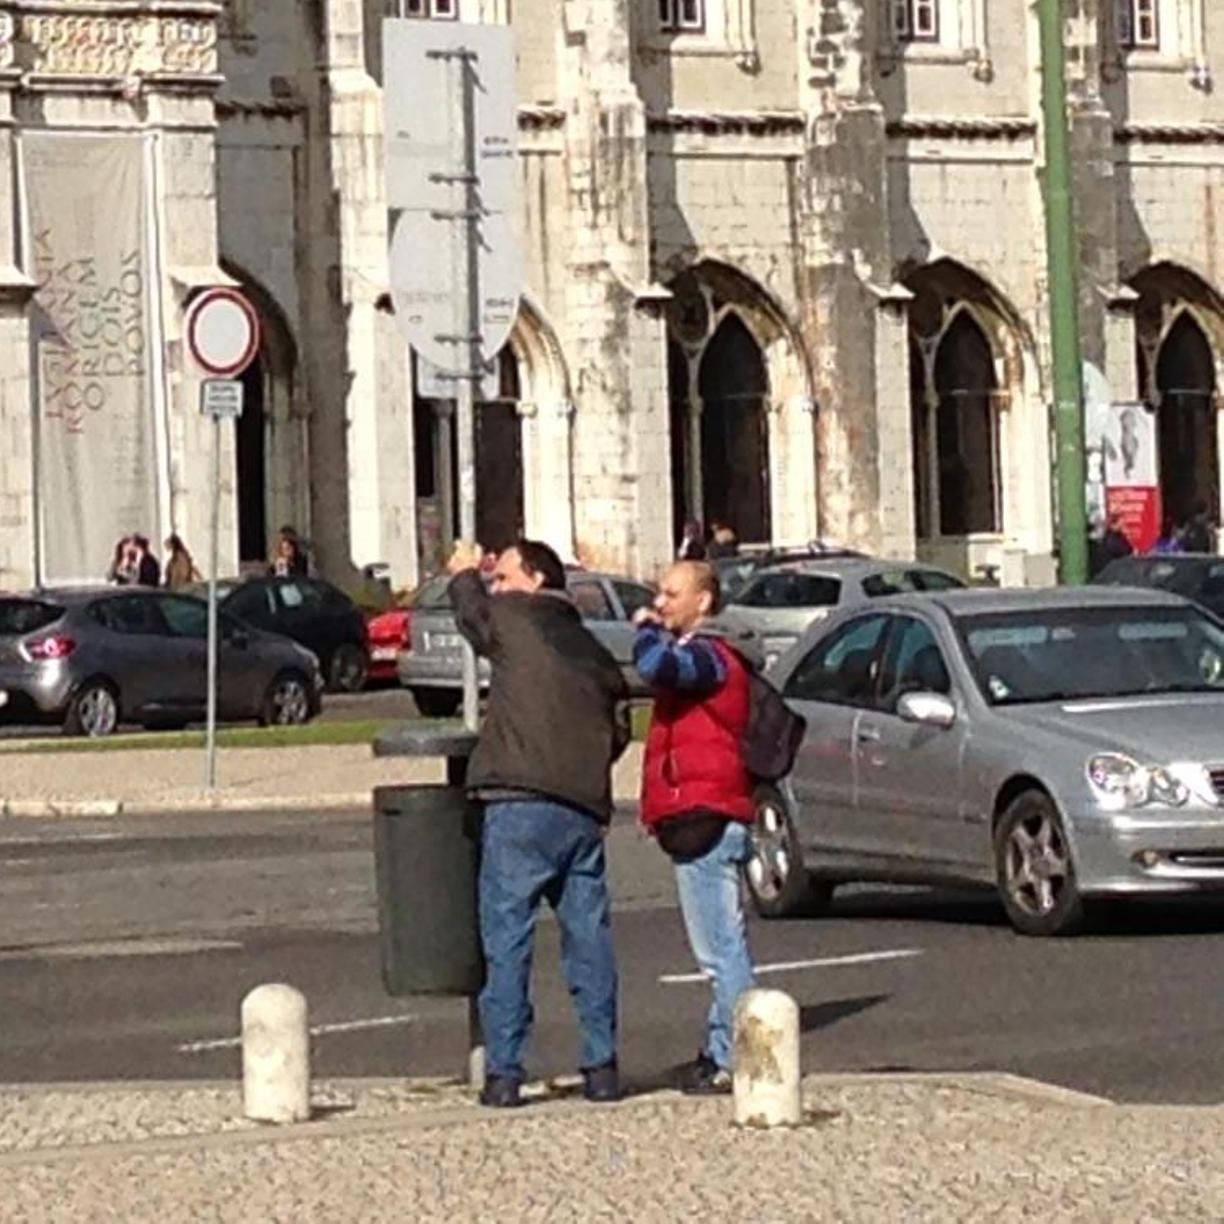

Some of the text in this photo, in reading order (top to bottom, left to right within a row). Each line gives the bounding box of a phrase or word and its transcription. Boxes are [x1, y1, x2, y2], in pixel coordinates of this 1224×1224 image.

[56, 262, 84, 435] ROMANA
[101, 287, 125, 377] DOIS
[121, 249, 145, 377] POVOS
